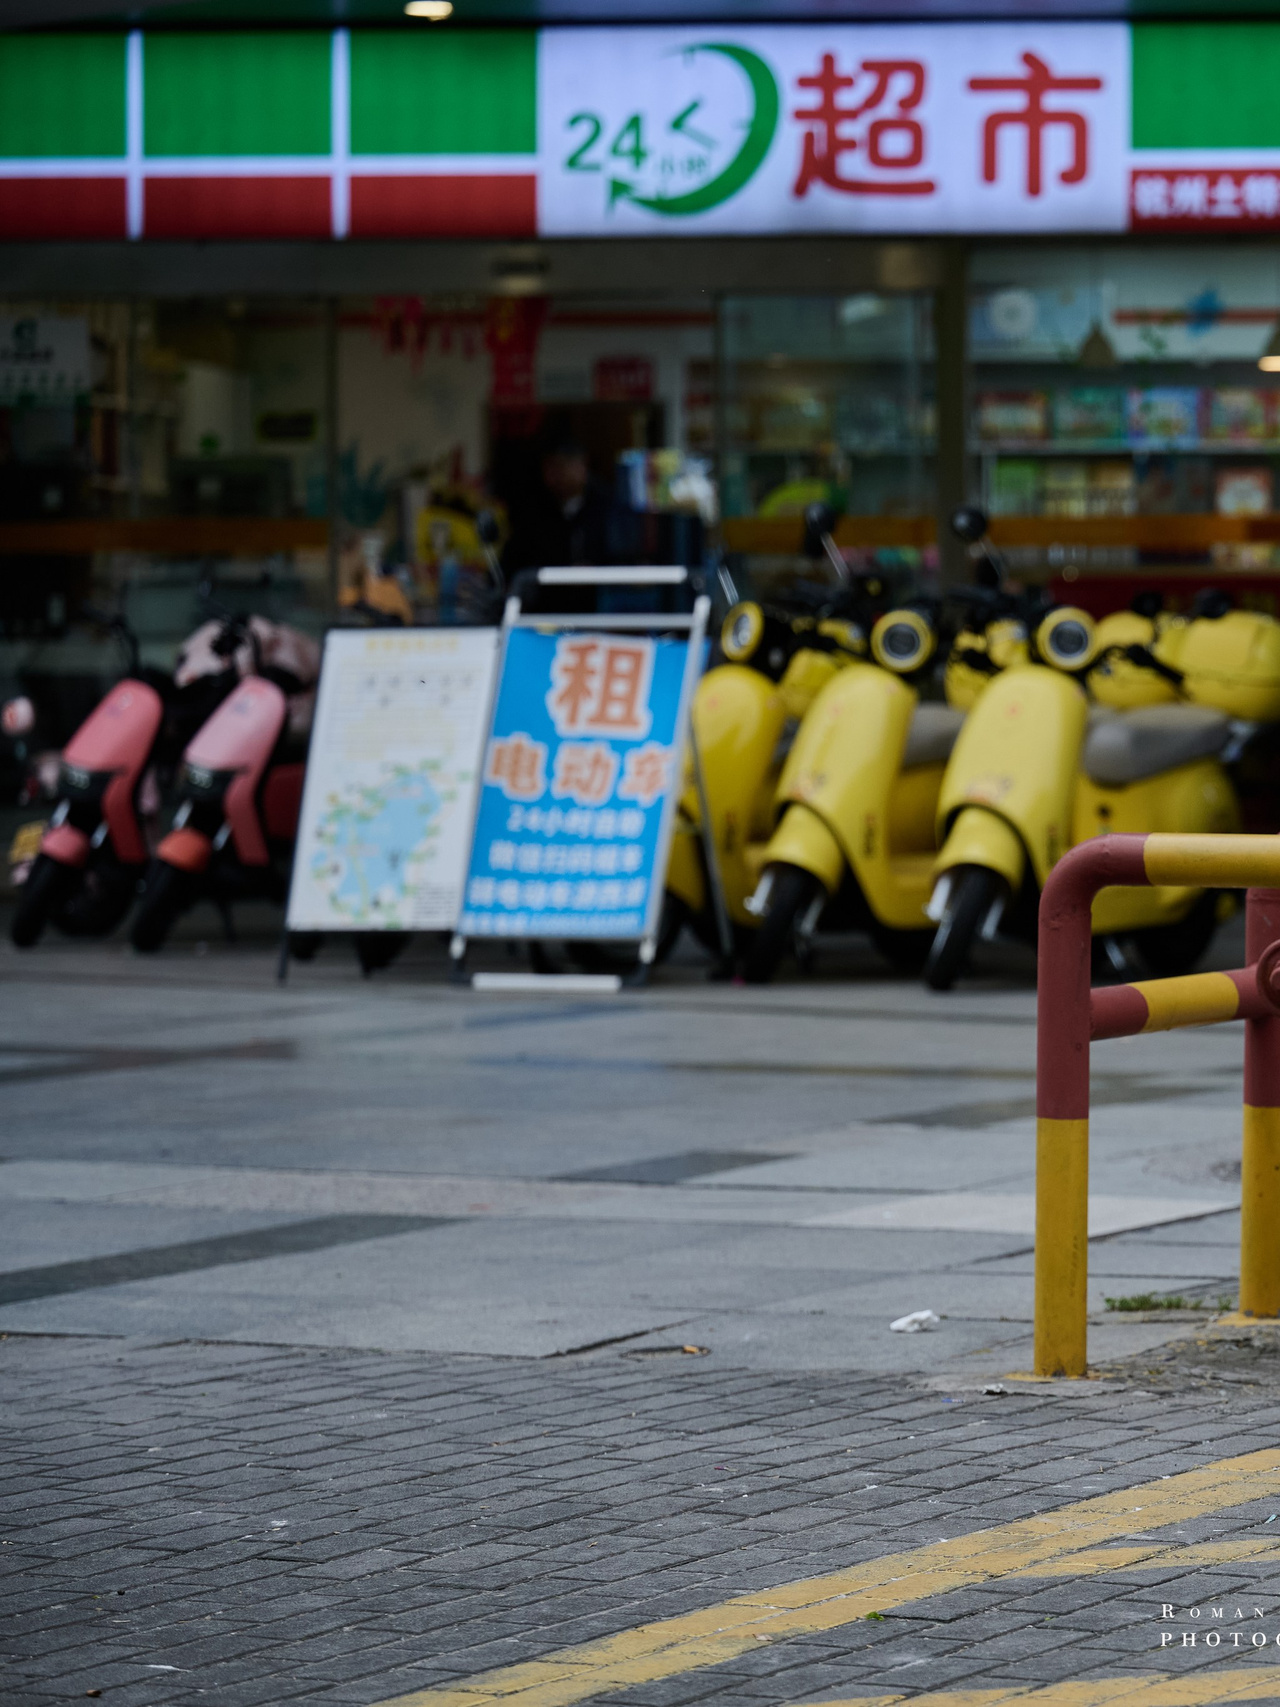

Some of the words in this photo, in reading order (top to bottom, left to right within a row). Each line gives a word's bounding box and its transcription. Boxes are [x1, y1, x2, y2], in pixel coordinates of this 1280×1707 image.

[566, 112, 648, 171] 24
[794, 51, 1103, 198] 超市
[552, 640, 650, 733] 租
[486, 735, 674, 801] 电动车
